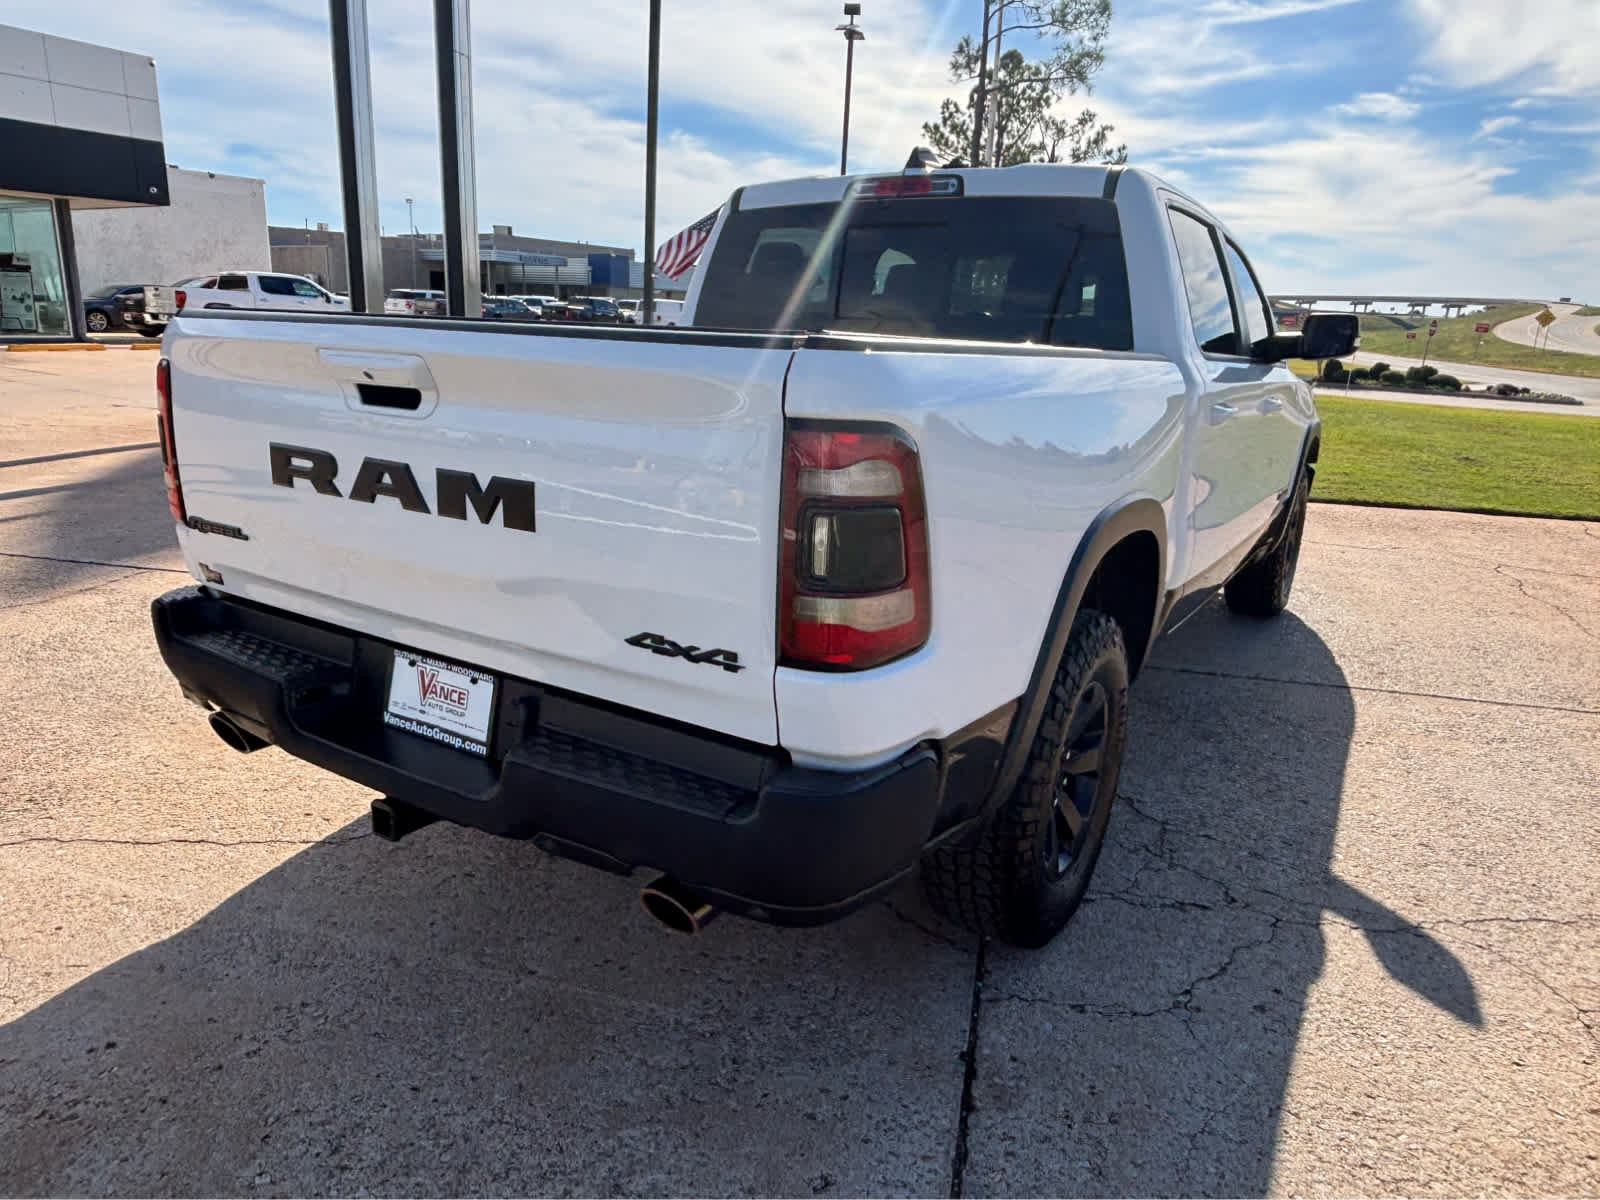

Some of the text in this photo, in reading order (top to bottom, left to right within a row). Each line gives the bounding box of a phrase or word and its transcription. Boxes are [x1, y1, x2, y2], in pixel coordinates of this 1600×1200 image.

[269, 441, 536, 533] RAM
[418, 667, 467, 706] VANCE
[451, 665, 494, 682] WOODWARD
[428, 701, 466, 718] AUTO GROUP
[384, 711, 487, 755] VanceAutoGroup.com
